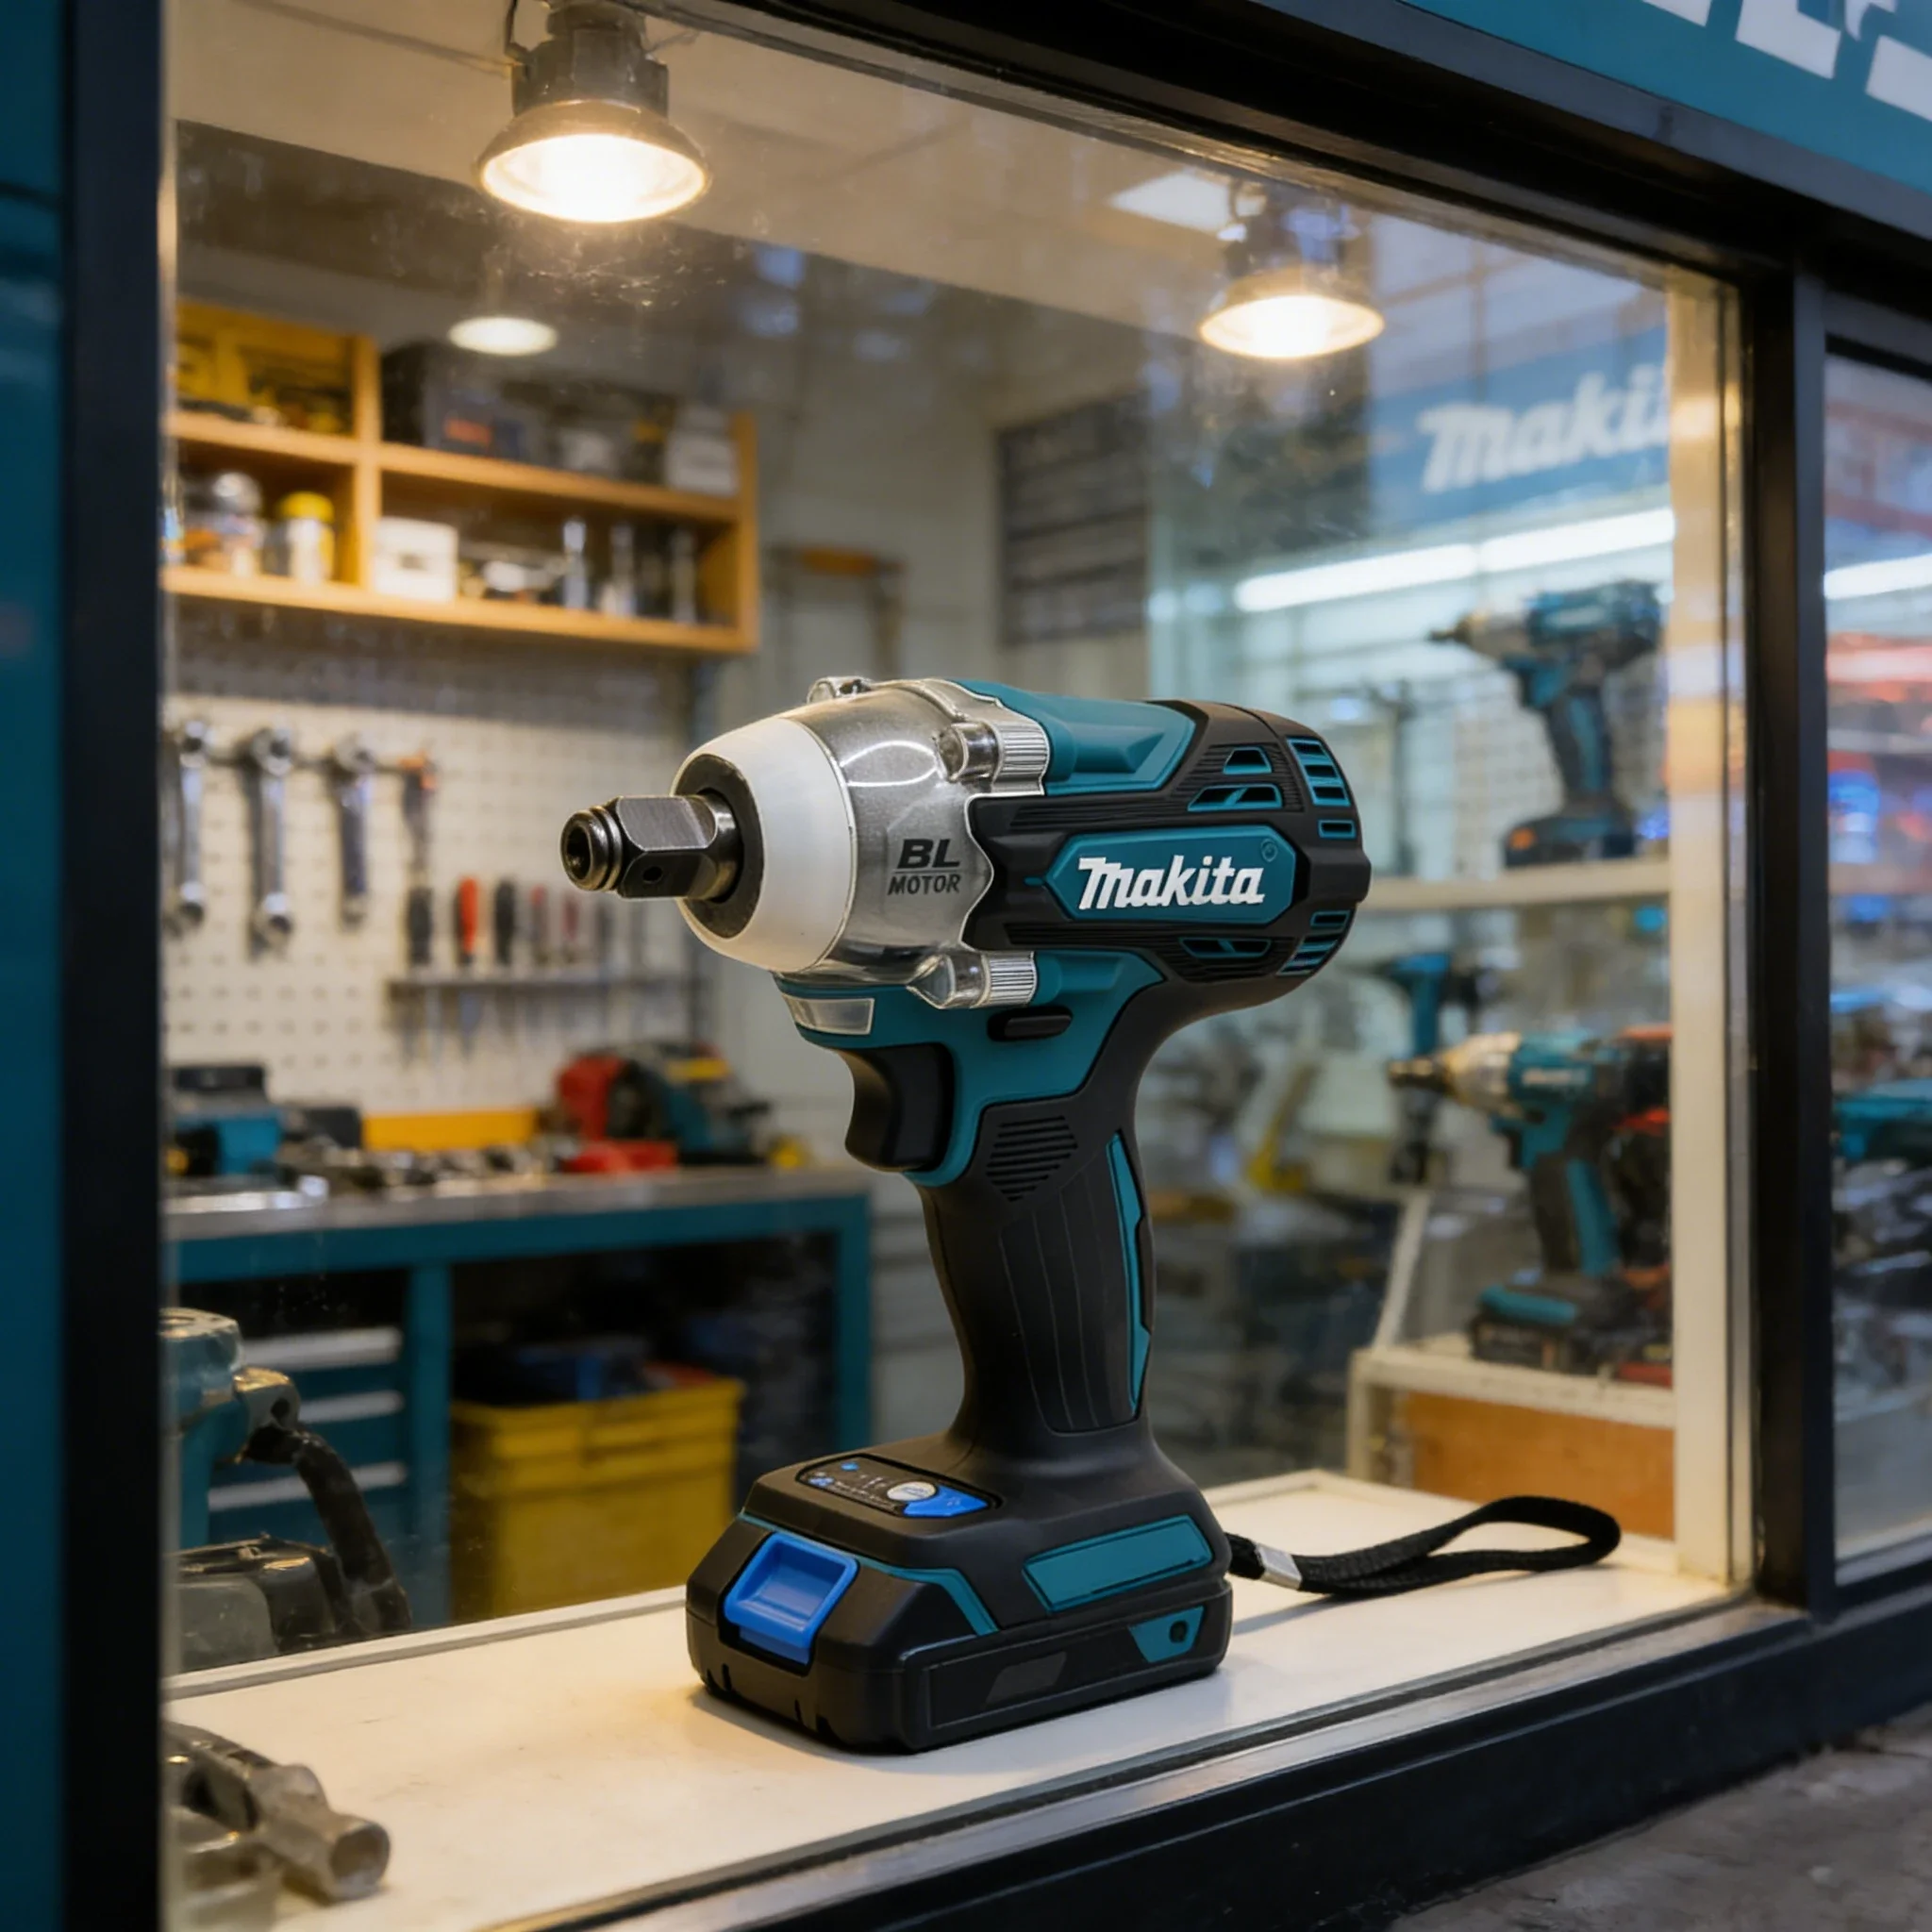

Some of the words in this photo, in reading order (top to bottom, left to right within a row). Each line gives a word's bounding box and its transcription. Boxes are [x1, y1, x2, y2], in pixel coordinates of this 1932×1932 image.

[897, 839, 960, 869] BL
[888, 874, 961, 895] MOTOR
[1078, 855, 1265, 909] Makita
